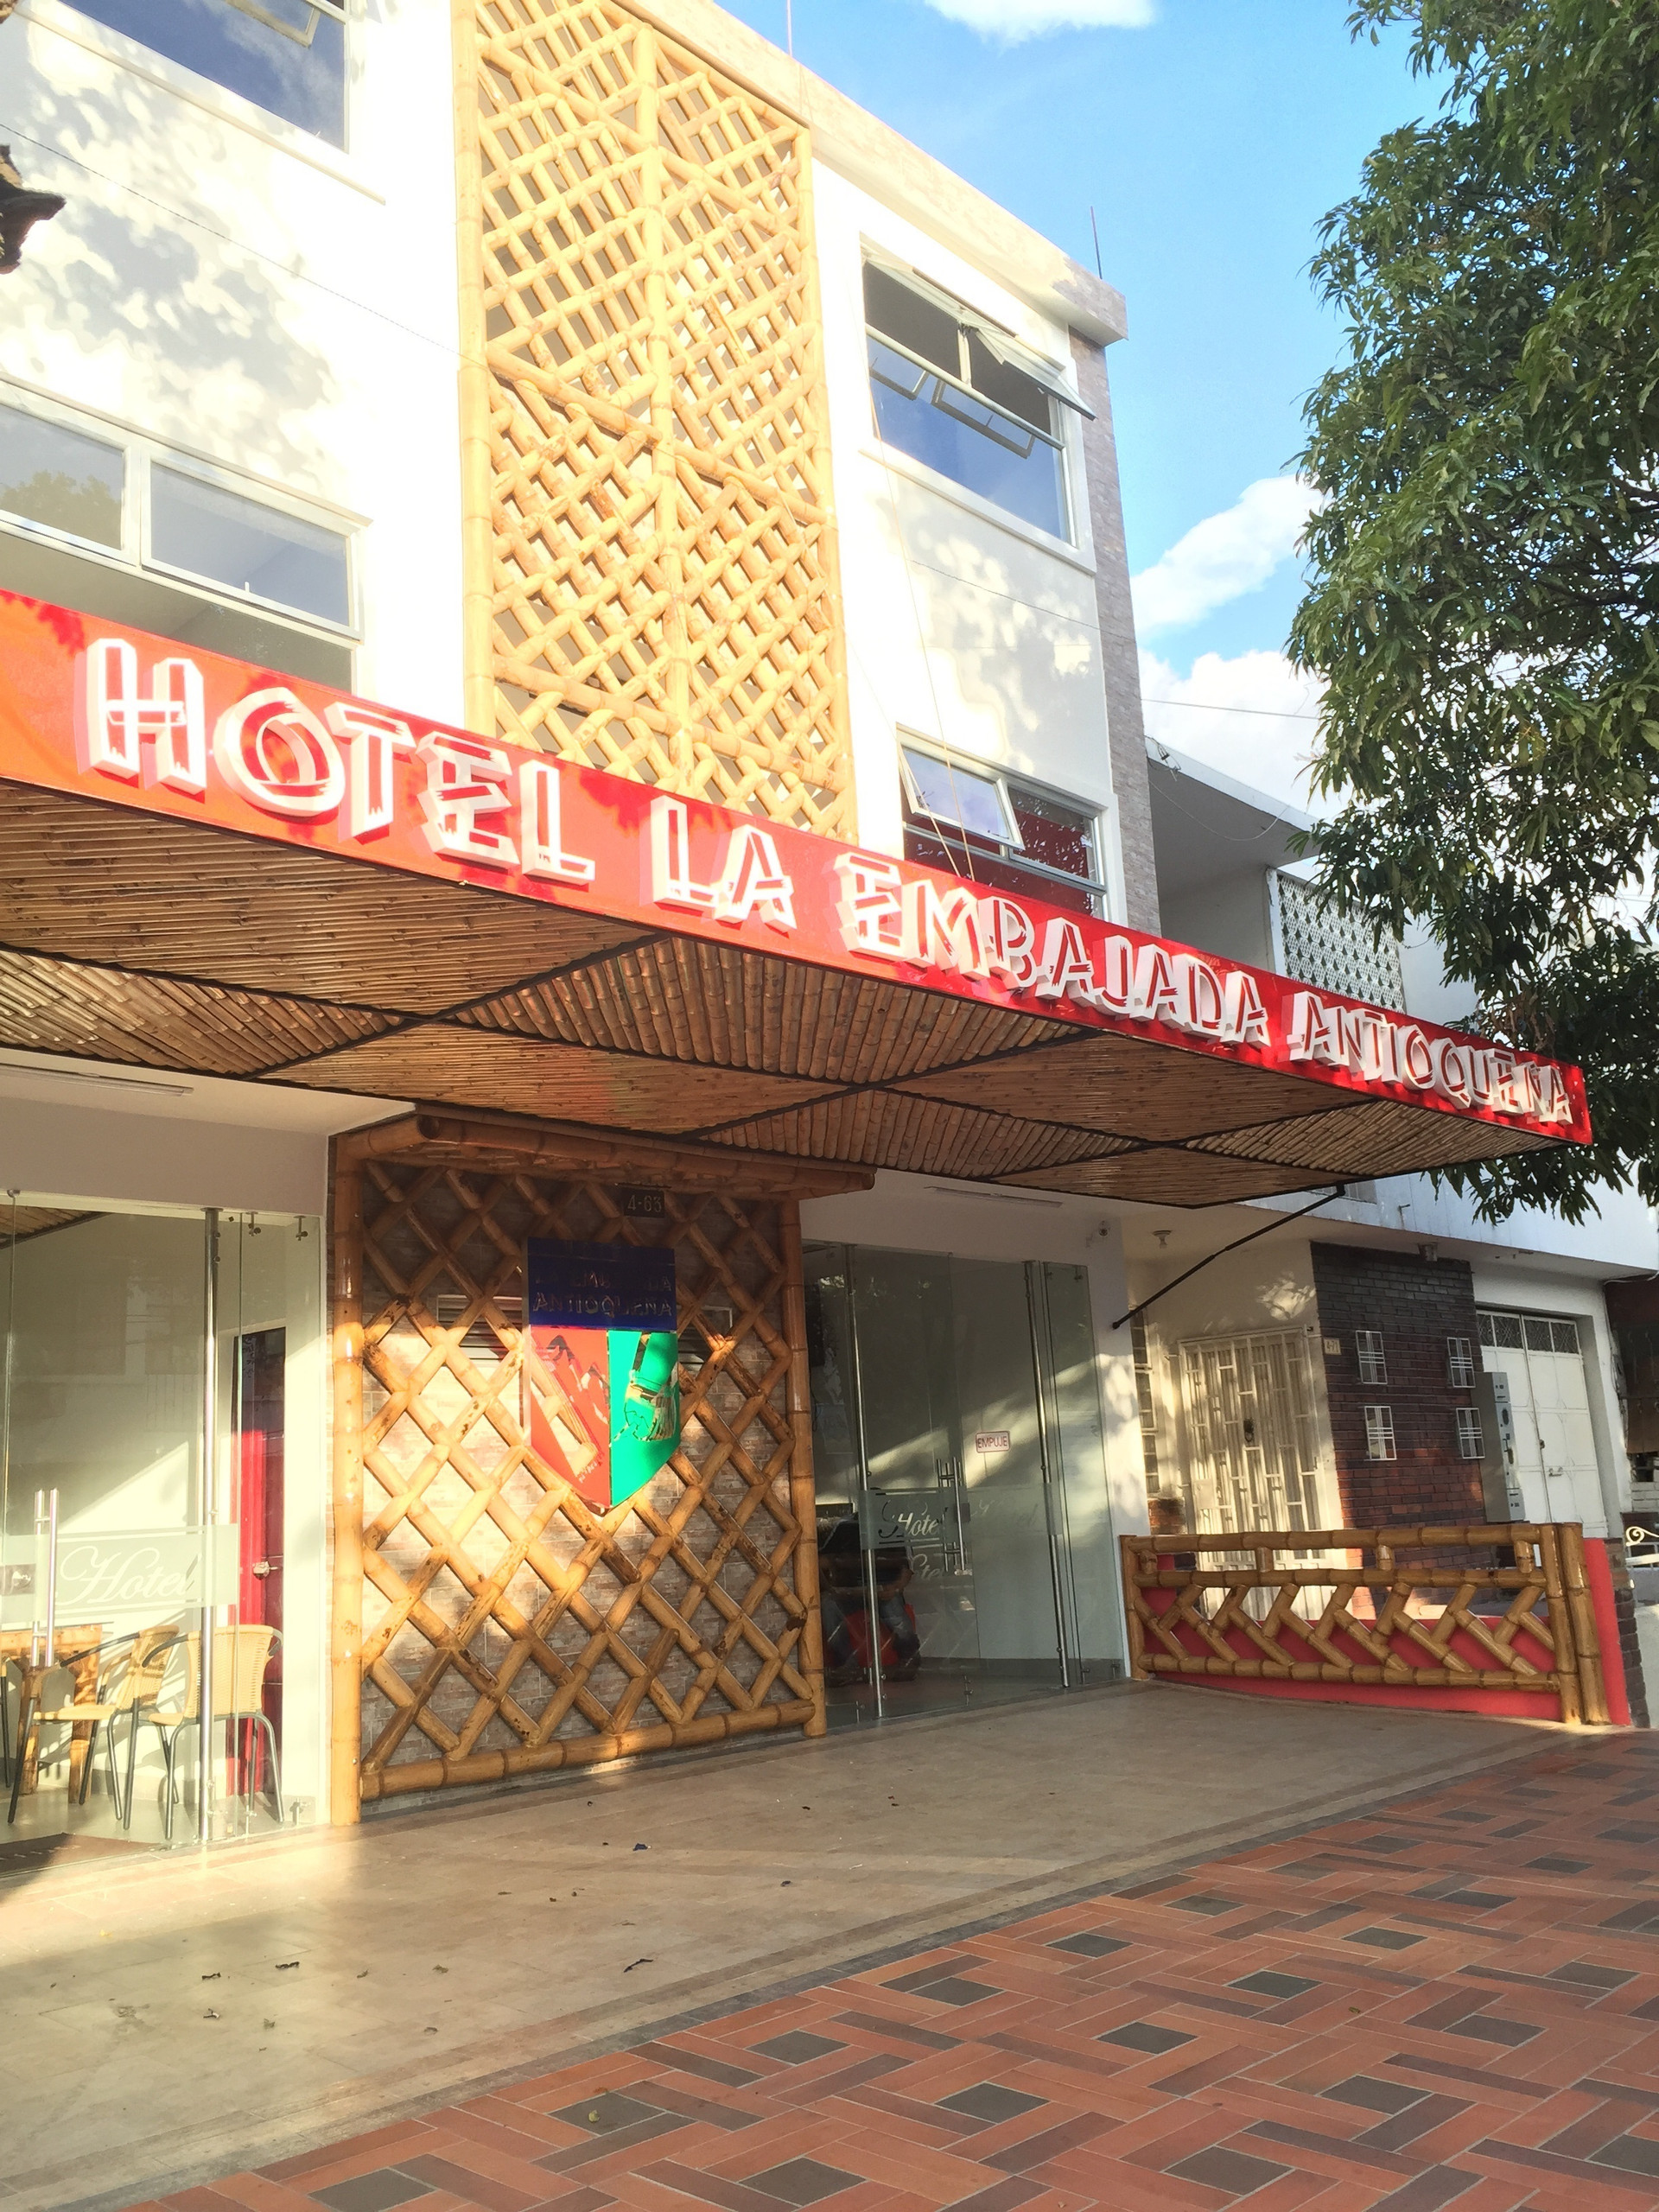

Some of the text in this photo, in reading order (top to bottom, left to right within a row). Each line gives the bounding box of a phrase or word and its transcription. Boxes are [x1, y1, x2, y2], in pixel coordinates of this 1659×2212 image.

[85, 638, 596, 885] HOTEL
[650, 795, 797, 931] LA
[835, 851, 1271, 1047] EMBAJADA
[976, 1433, 1008, 1449] EMPUJE
